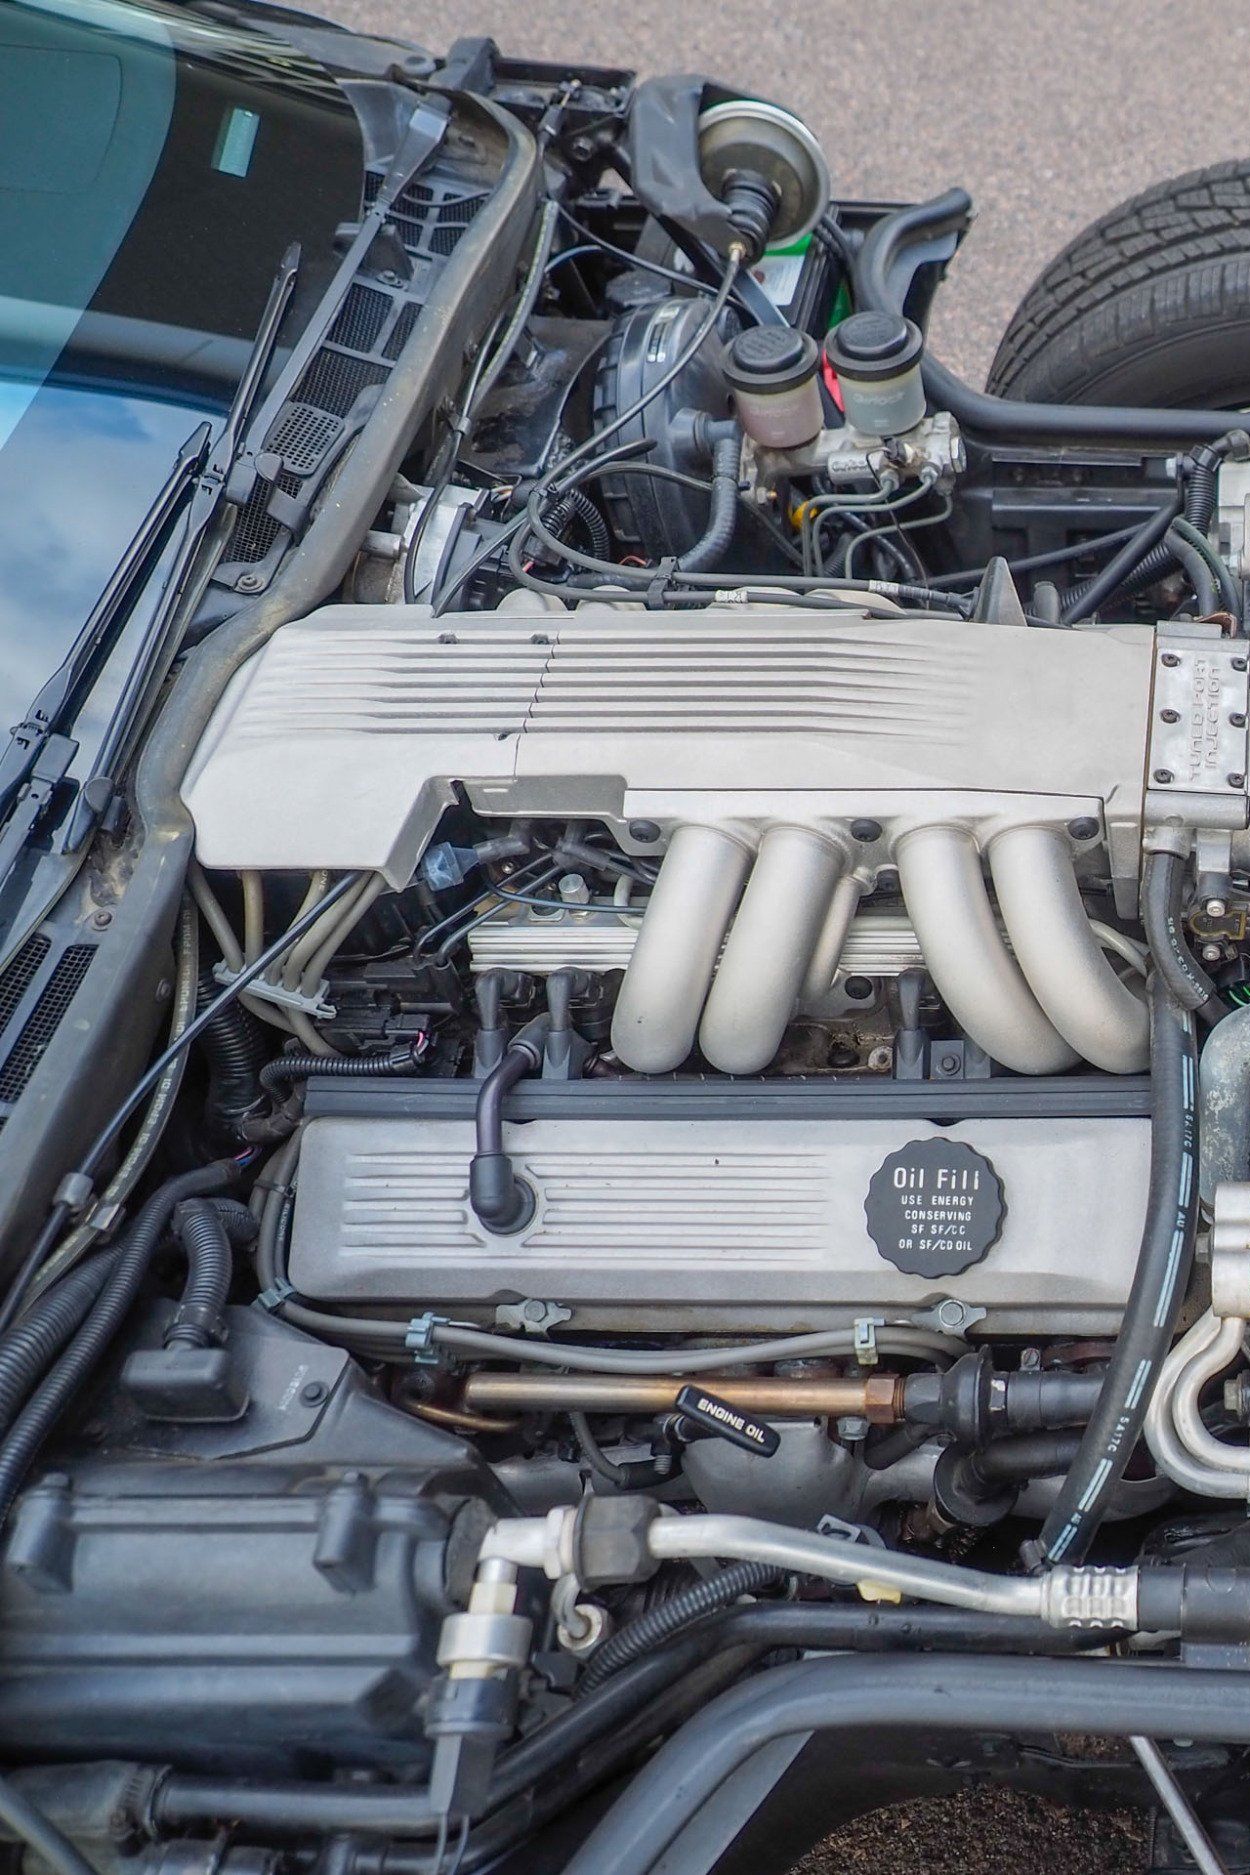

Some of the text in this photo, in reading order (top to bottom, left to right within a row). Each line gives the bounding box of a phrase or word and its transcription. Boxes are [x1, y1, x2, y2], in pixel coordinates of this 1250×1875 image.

[1205, 668, 1220, 769] INJECTION
[893, 1167, 980, 1190] Oil Fill
[901, 1195, 975, 1206] USE ENERGY
[904, 1210, 972, 1221] CONSERVING
[911, 1224, 966, 1235] SF SF/CC
[898, 1239, 973, 1251] OR SF/CD OIL
[697, 1398, 765, 1444] ENGINE OIL
